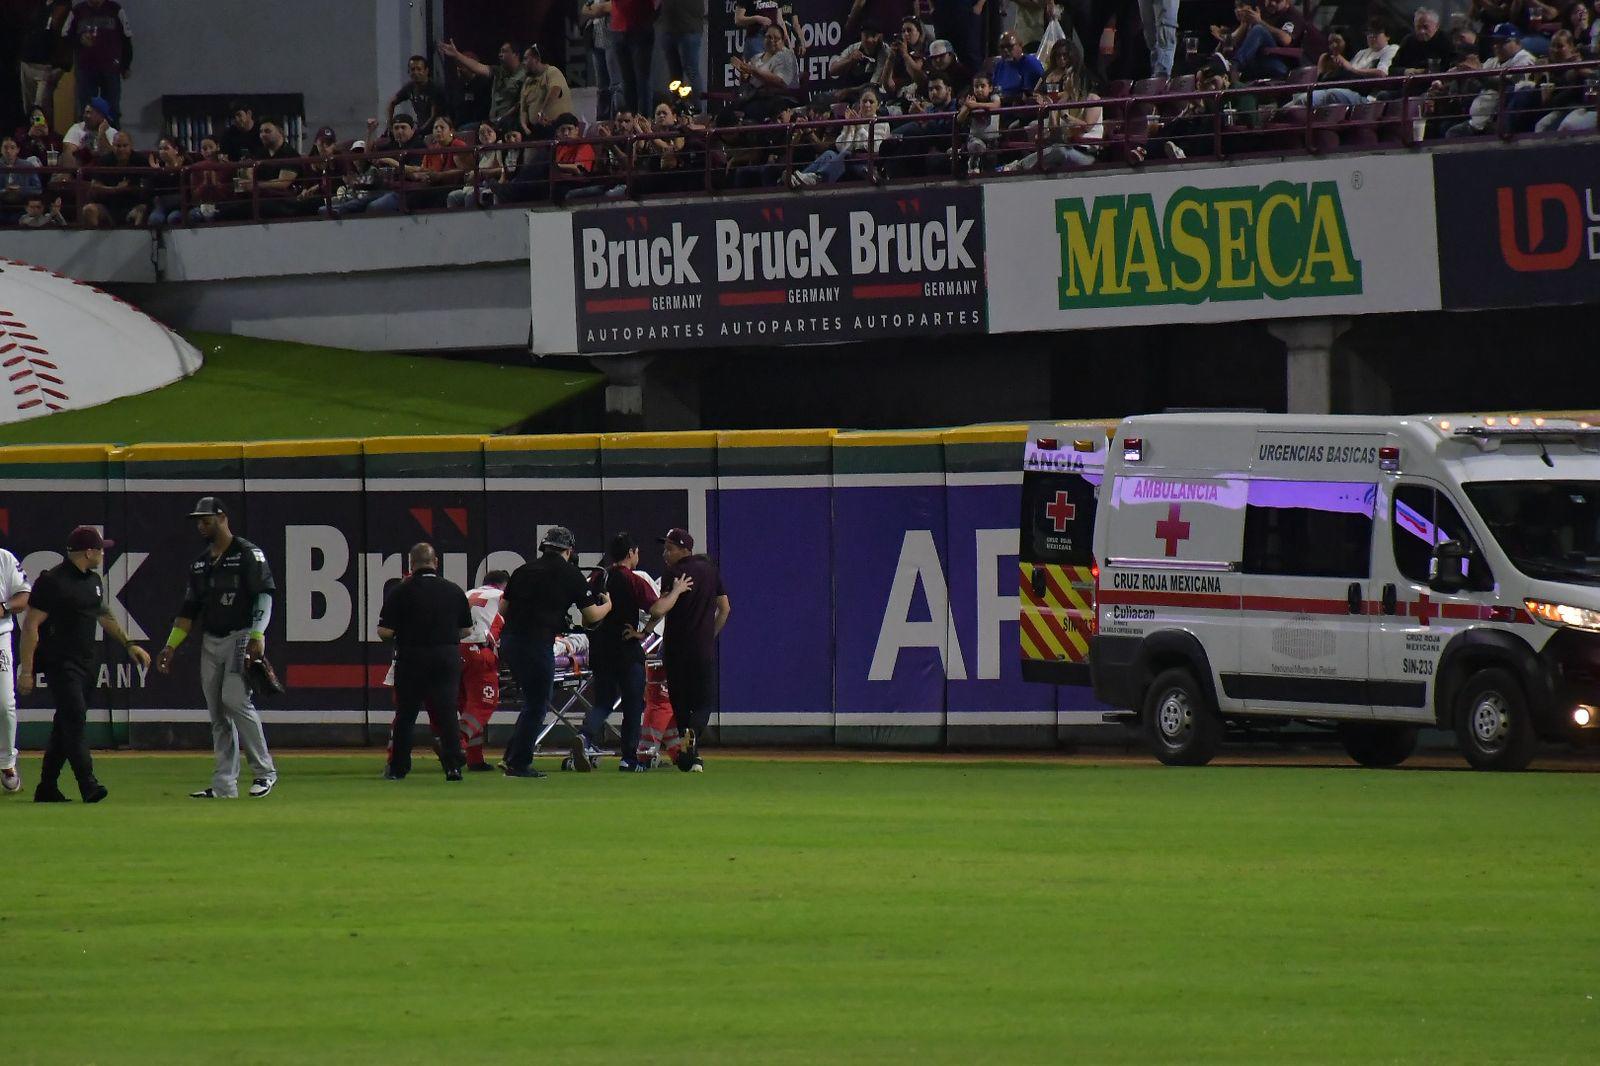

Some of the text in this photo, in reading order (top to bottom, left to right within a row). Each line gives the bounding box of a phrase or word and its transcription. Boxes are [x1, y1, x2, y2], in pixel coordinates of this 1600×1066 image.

[1062, 190, 1356, 300] MASECA
[788, 287, 840, 303] GERMANY
[924, 280, 978, 297] GERMANY
[652, 294, 702, 311] GERMANY
[720, 317, 842, 336] AUTOPARTES
[854, 310, 979, 330] AUTOPARTES
[587, 323, 704, 342] AUTOPARTES
[1259, 444, 1376, 464] URGENCIAS BASICAS
[1133, 480, 1218, 500] AMBULANCIA
[1113, 573, 1222, 593] CRUZ ROJA MEXICANA
[1402, 658, 1433, 675] SIN-233
